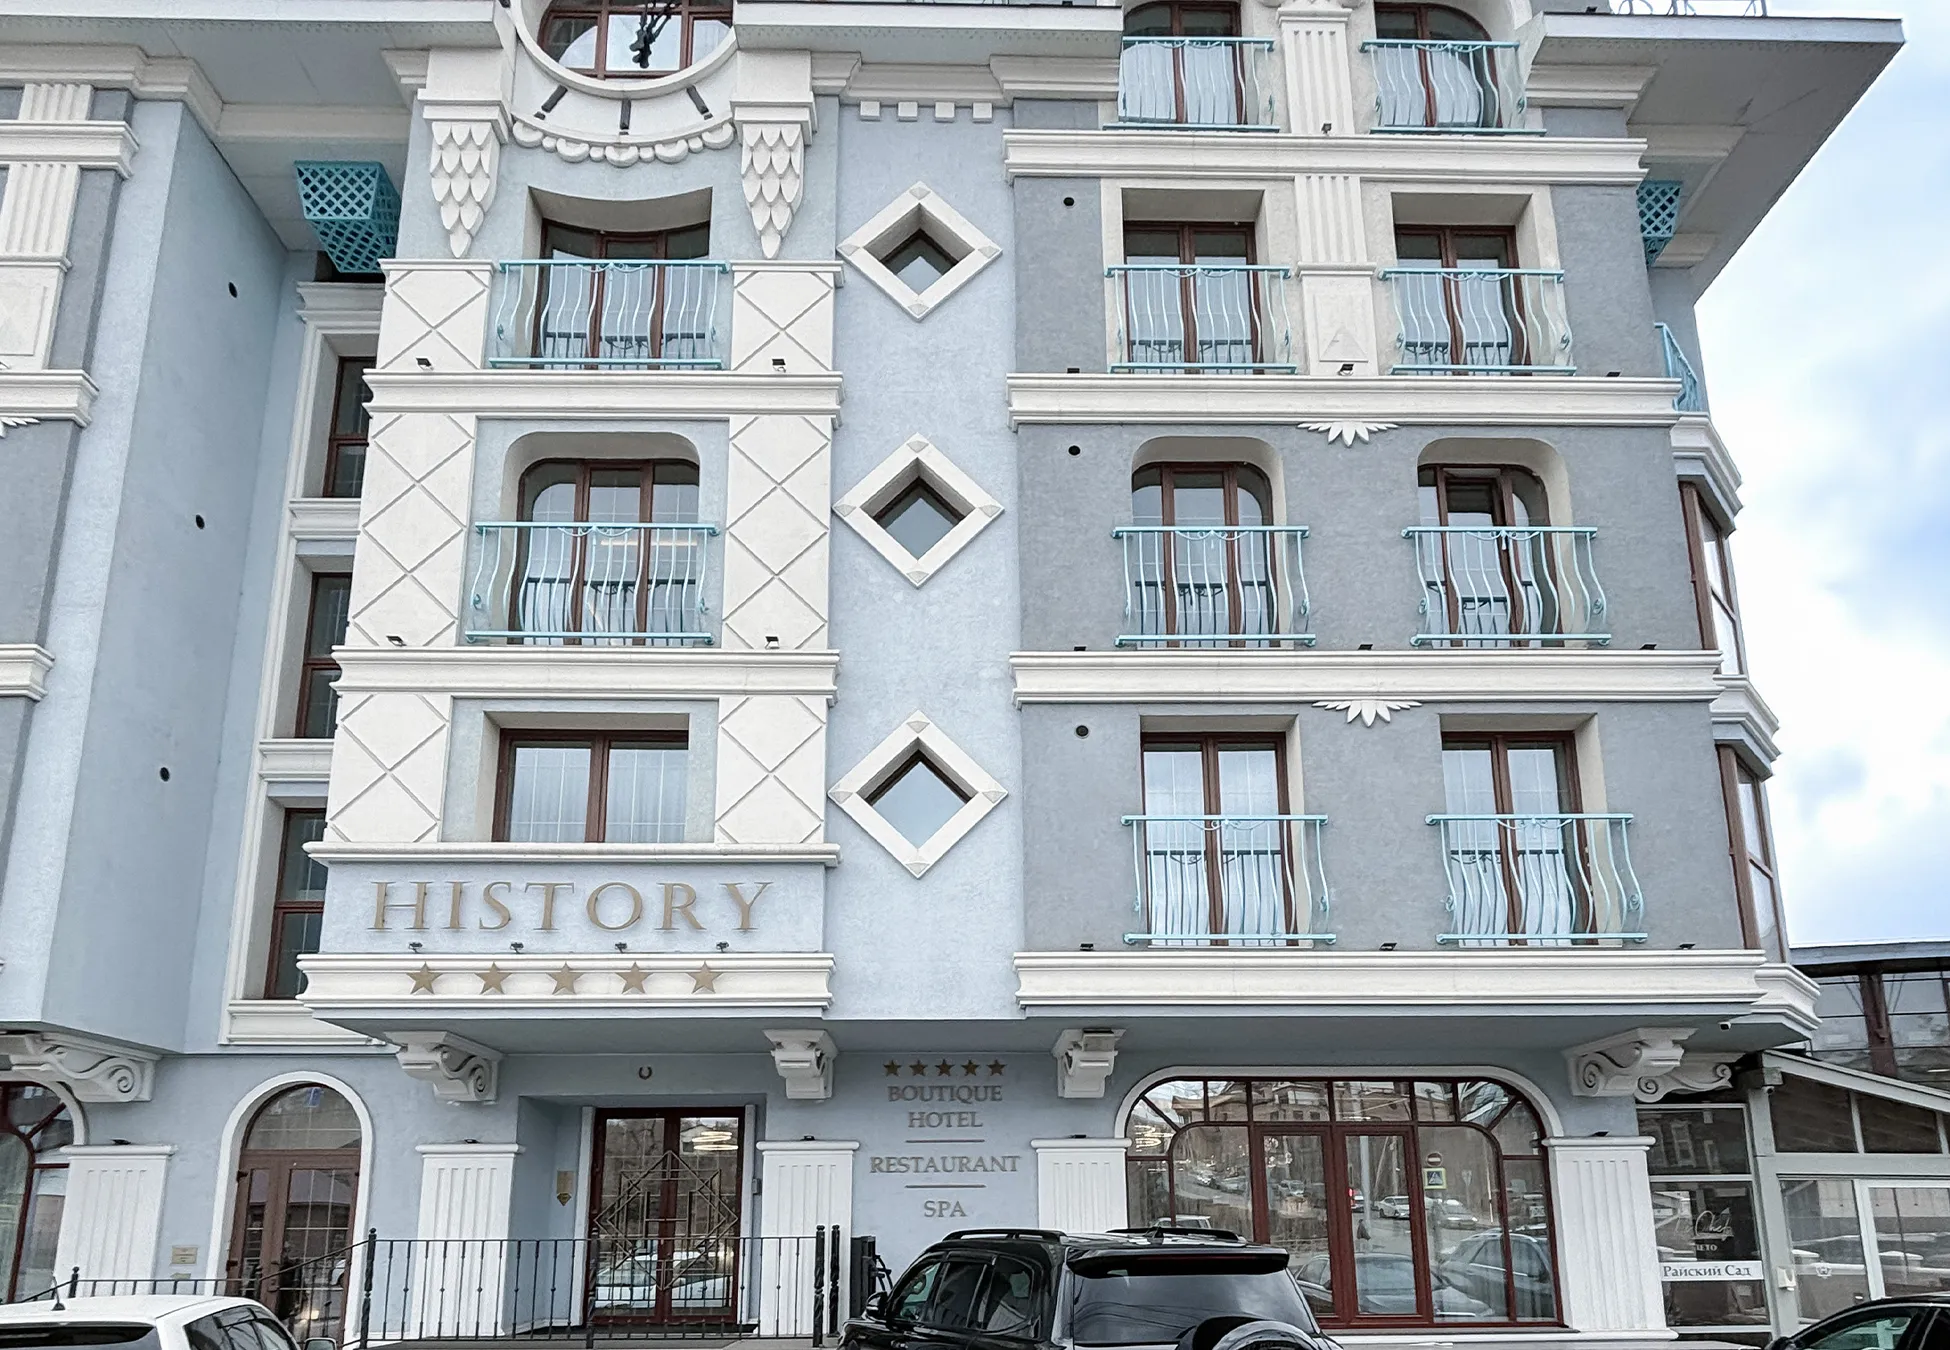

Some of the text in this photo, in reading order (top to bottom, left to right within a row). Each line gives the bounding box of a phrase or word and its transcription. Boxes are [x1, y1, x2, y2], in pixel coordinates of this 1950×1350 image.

[367, 881, 774, 931] HISTORY
[887, 1085, 1003, 1104] BOUTIQUE
[908, 1111, 983, 1128] HOTEL
[870, 1155, 1021, 1174] RESTAURANT
[923, 1200, 967, 1218] SPA
[1662, 1264, 1752, 1277] Райский Сад
